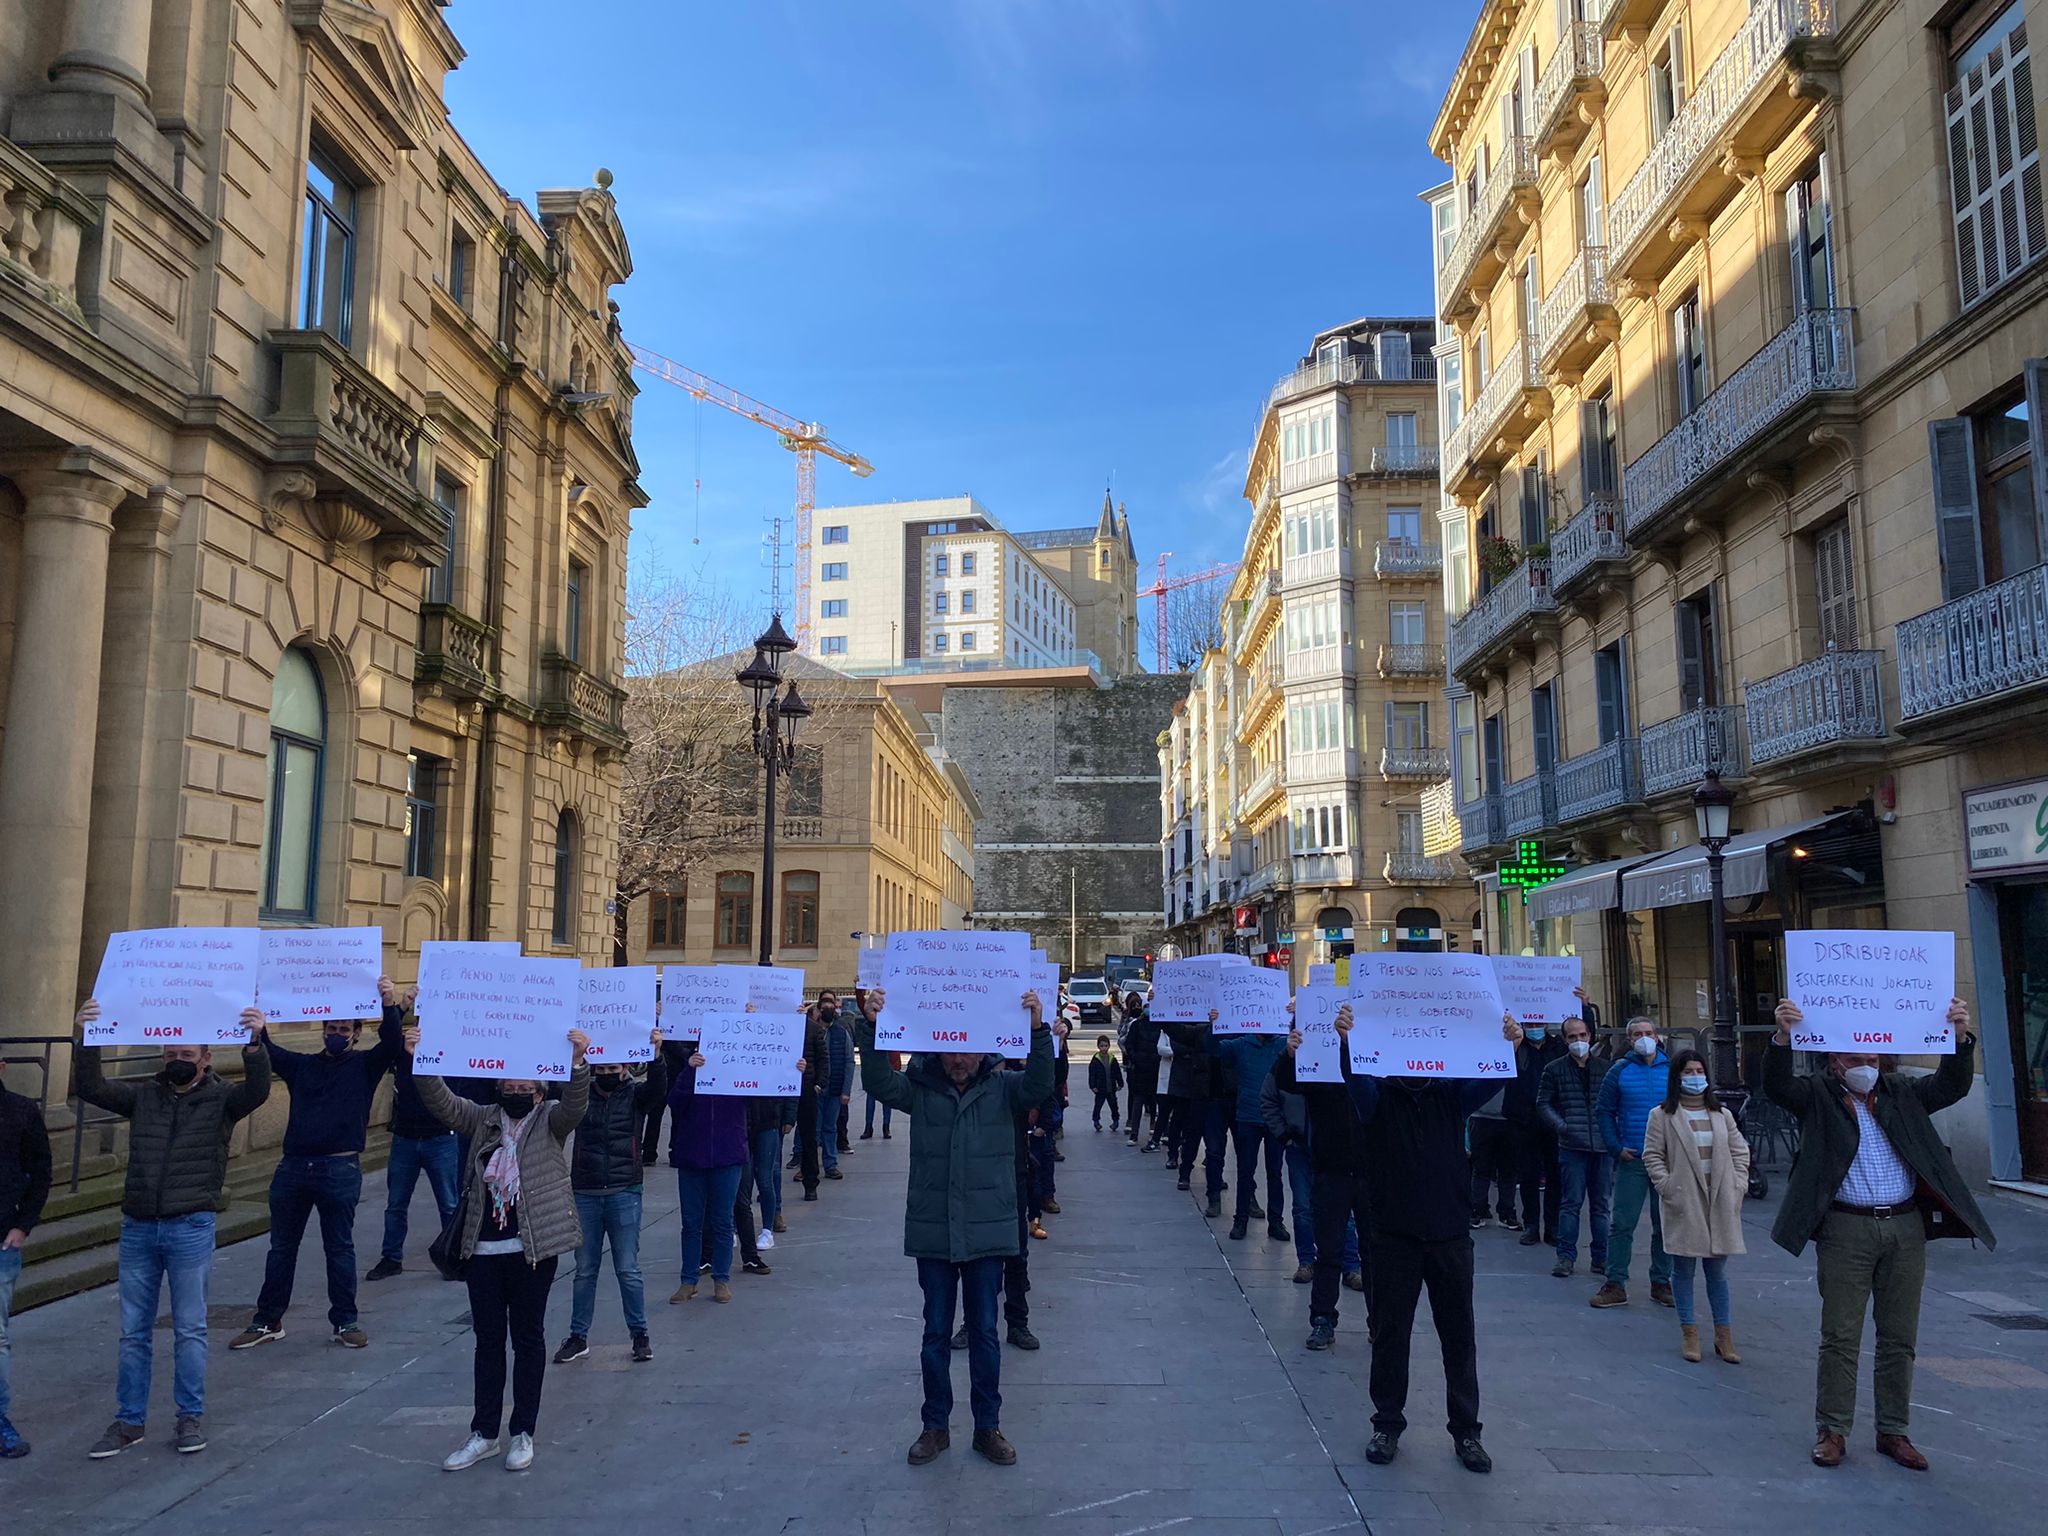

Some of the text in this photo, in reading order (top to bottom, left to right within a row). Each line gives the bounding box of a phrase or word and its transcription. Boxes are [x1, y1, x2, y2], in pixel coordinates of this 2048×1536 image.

[1968, 792, 2037, 814] ENCUADERNACION
[1970, 822, 2010, 837] IMPRENTA
[140, 937, 175, 950] PIENSO
[894, 938, 1007, 953] EL PIENSO NOS AHOGA
[889, 964, 900, 977] LA
[961, 969, 977, 979] NOS
[980, 968, 1021, 979] REMATA
[1359, 963, 1370, 978] EL
[1376, 962, 1418, 976] PIENSO
[1424, 966, 1443, 977] NOS
[675, 972, 729, 988] DISTRIBUZIO
[1795, 972, 1933, 990] ESNEAREKIN JOKATUZ
[912, 982, 988, 994] Y EL GOBIERNO
[1223, 989, 1275, 1001] ESNETAN
[1352, 990, 1364, 1000] LA
[1437, 990, 1452, 1000] NOS
[1456, 990, 1494, 1001] REMATA
[140, 996, 191, 1008] AUSENTE
[917, 1000, 966, 1011] AUSENTE
[1802, 994, 1936, 1012] AKABATZEN GAITU
[302, 1006, 331, 1015] UAGN
[1383, 1007, 1473, 1020] Y EL GOBIERNO
[144, 1026, 182, 1037] UAGN
[461, 1025, 512, 1040] AUSENTE
[720, 1019, 785, 1035] DISTRIBUZIO
[1392, 1026, 1448, 1039] AUSENTE
[932, 1031, 968, 1042] UAGN
[1853, 1032, 1892, 1043] UAGN
[706, 1041, 790, 1053] KATEEK KATEATZEN
[468, 1058, 505, 1070] UAGN
[1406, 1060, 1444, 1071] UAGN
[733, 1081, 758, 1089] UAGN
